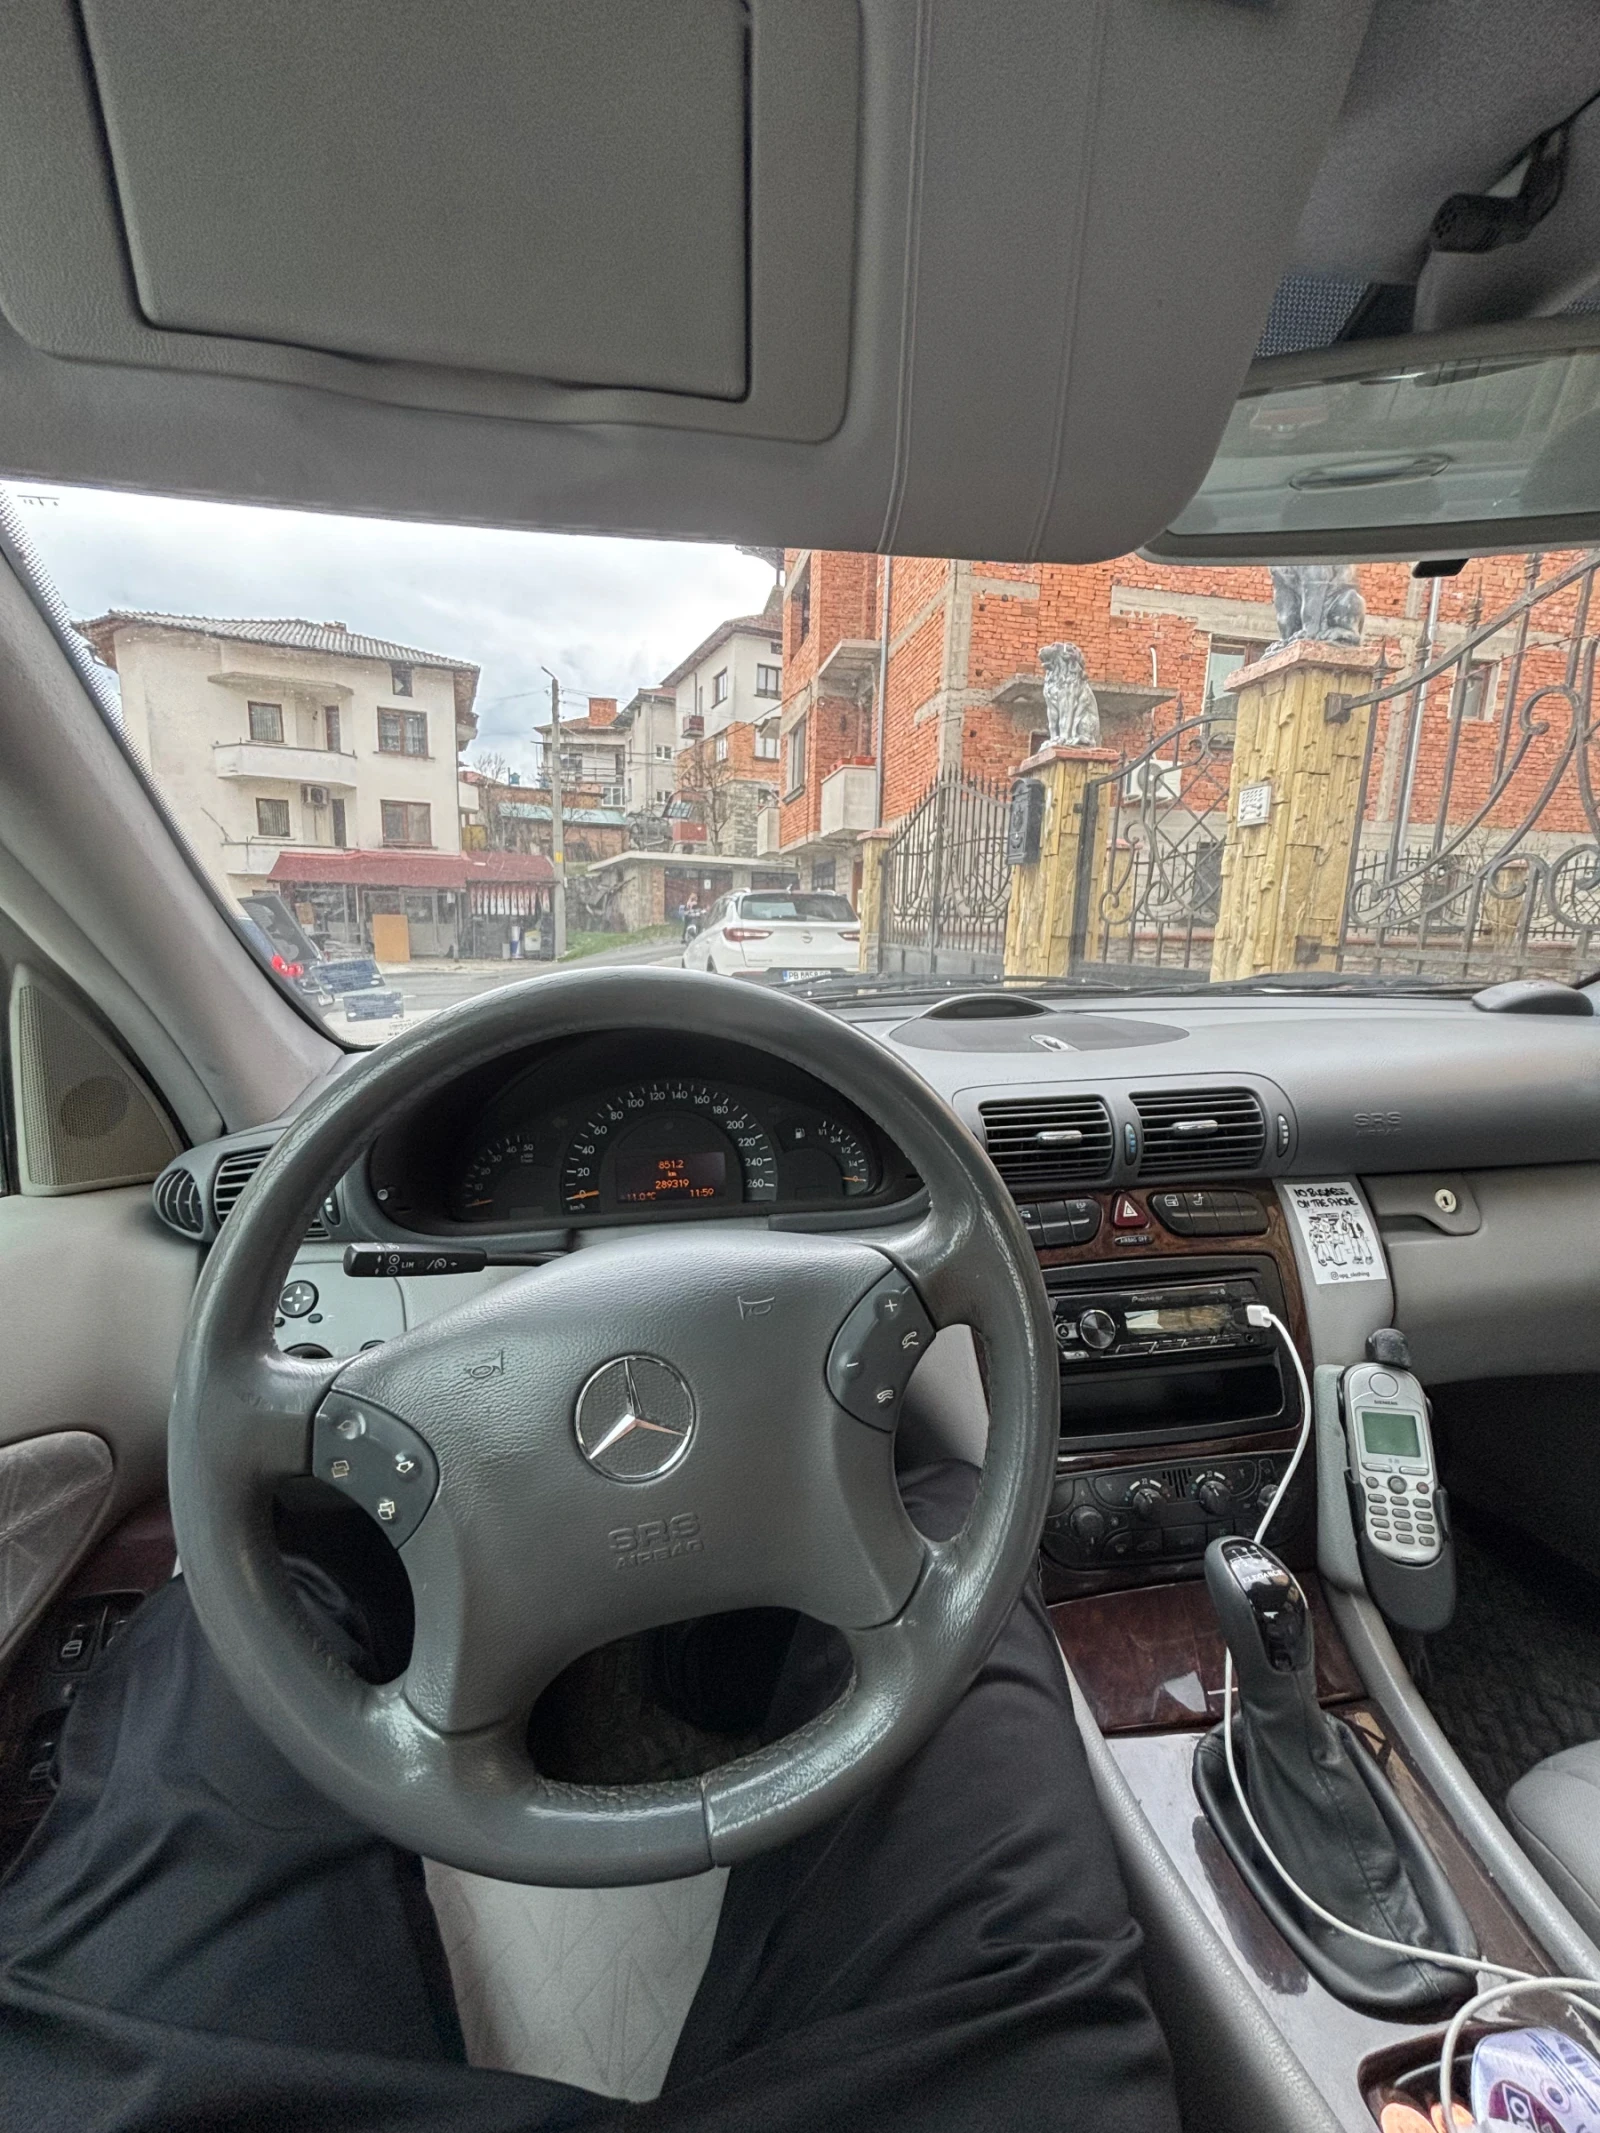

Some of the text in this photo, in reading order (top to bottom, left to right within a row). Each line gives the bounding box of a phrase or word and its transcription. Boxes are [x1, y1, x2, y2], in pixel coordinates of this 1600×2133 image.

[649, 1091, 666, 1100] 120
[672, 1090, 688, 1099] 140
[627, 1098, 644, 1108] 100
[694, 1095, 710, 1104] 160
[712, 1105, 729, 1114] 180
[610, 1111, 624, 1120] 80
[1354, 1111, 1402, 1127] SRS
[726, 1120, 744, 1129] 200
[594, 1125, 608, 1135] 60
[523, 1143, 534, 1151] 50
[738, 1138, 756, 1147] 220
[581, 1145, 595, 1155] 40
[841, 1146, 851, 1154] 1/2
[491, 1155, 502, 1163] 30
[745, 1157, 763, 1167] 240
[658, 1160, 684, 1170] 851.2
[480, 1167, 491, 1175] 20
[577, 1167, 590, 1177] 20
[655, 1179, 690, 1190] 289319
[747, 1178, 764, 1188] 260
[690, 1188, 714, 1197] 11:59
[1297, 1197, 1359, 1209] ON THE PHONE
[401, 1261, 415, 1269] LIM
[607, 1511, 701, 1553] SRS
[1242, 1569, 1283, 1584] ELEGANCE
